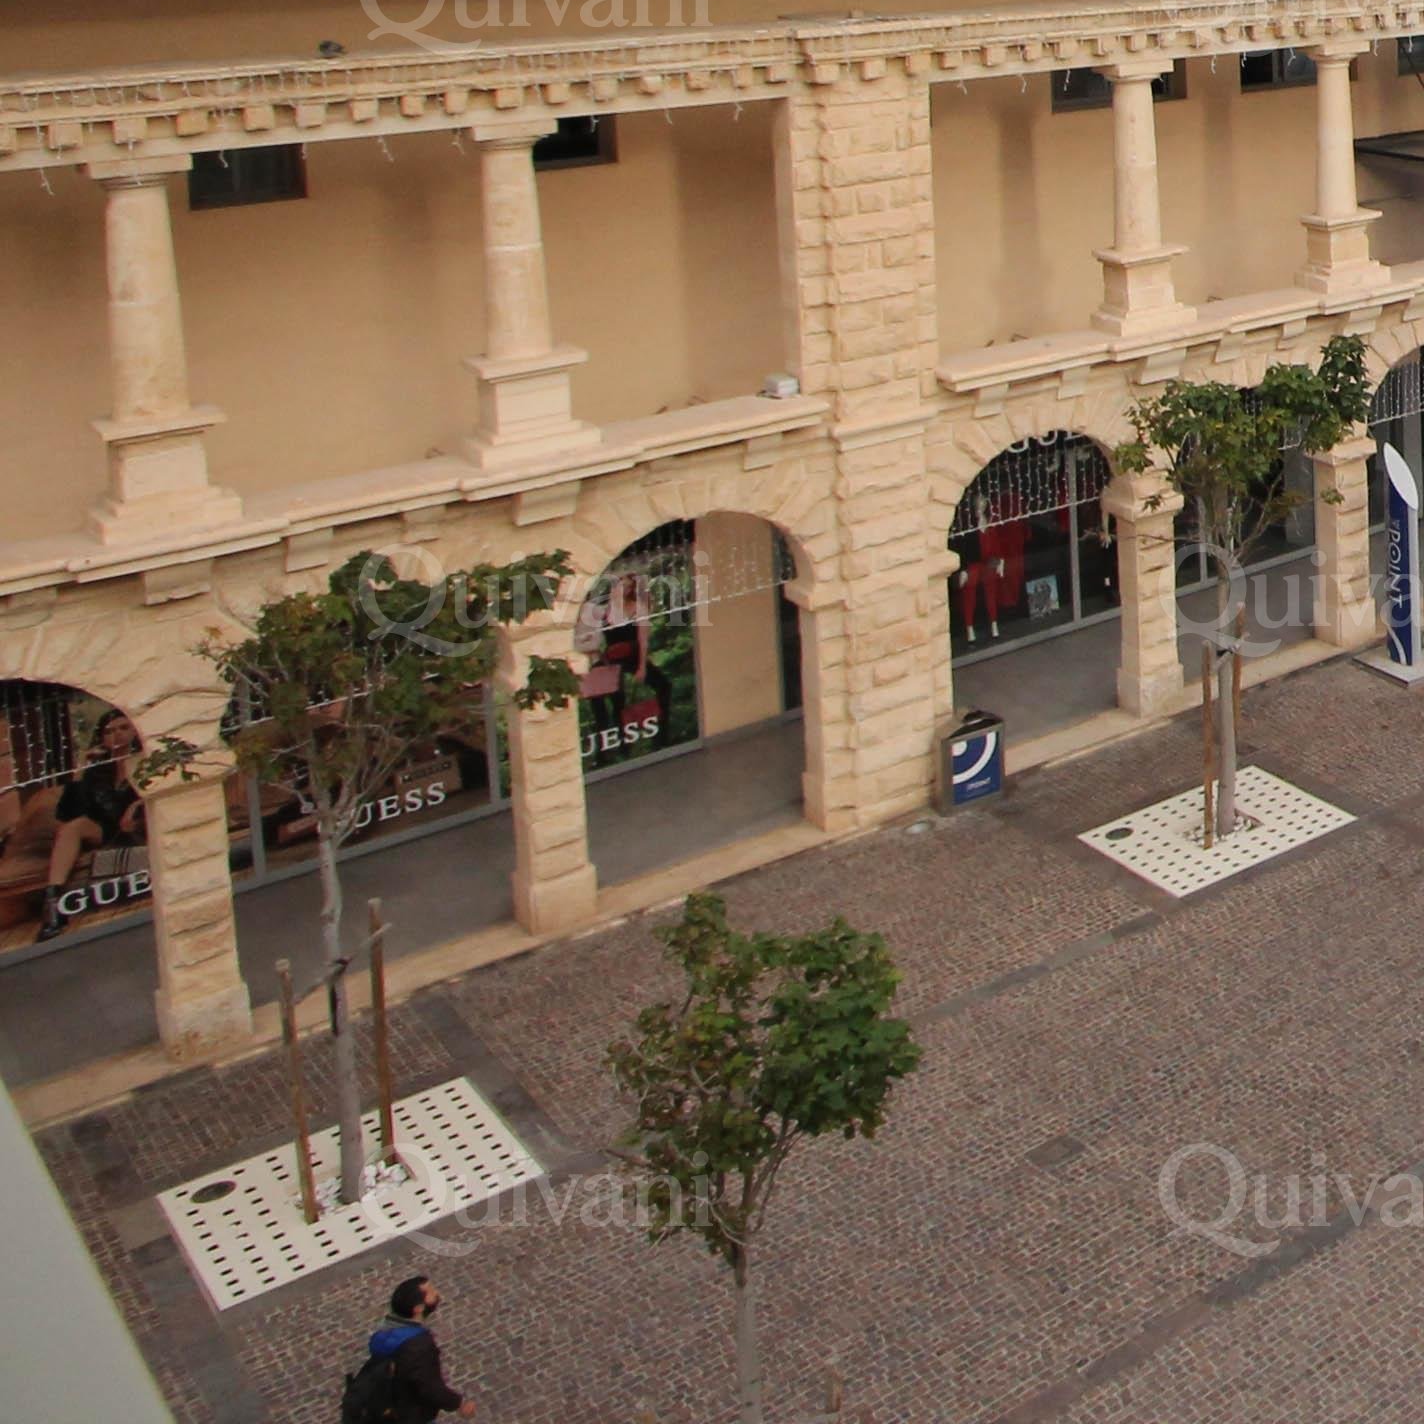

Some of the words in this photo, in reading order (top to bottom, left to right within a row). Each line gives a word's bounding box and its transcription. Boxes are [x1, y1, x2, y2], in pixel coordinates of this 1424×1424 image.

[580, 716, 659, 757] UESS
[317, 782, 446, 833] UESS
[57, 870, 152, 915] GUE
